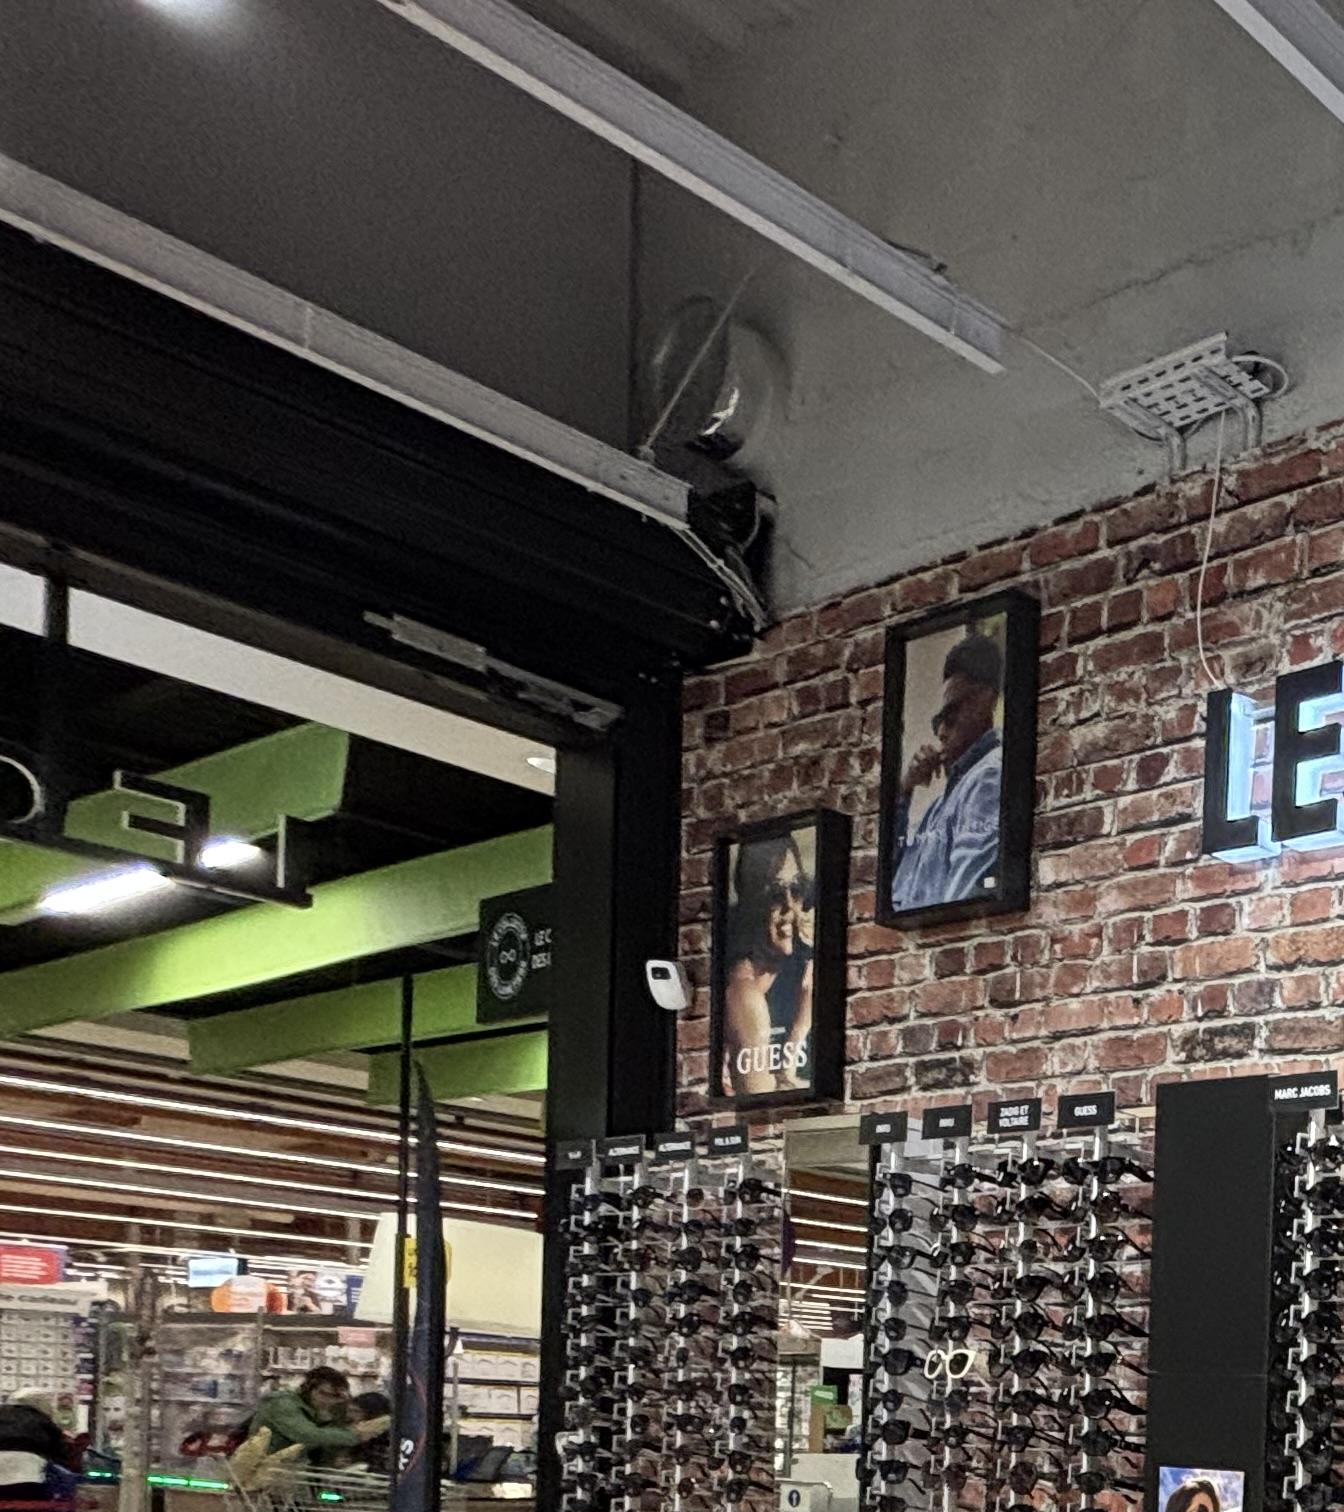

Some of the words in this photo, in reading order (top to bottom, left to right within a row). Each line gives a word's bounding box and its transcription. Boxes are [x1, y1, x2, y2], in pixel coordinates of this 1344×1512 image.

[736, 1040, 808, 1075] GUESS
[1274, 1087, 1298, 1101] MARC
[1298, 1084, 1332, 1098] JACOBS
[1073, 1104, 1098, 1117] GUESS
